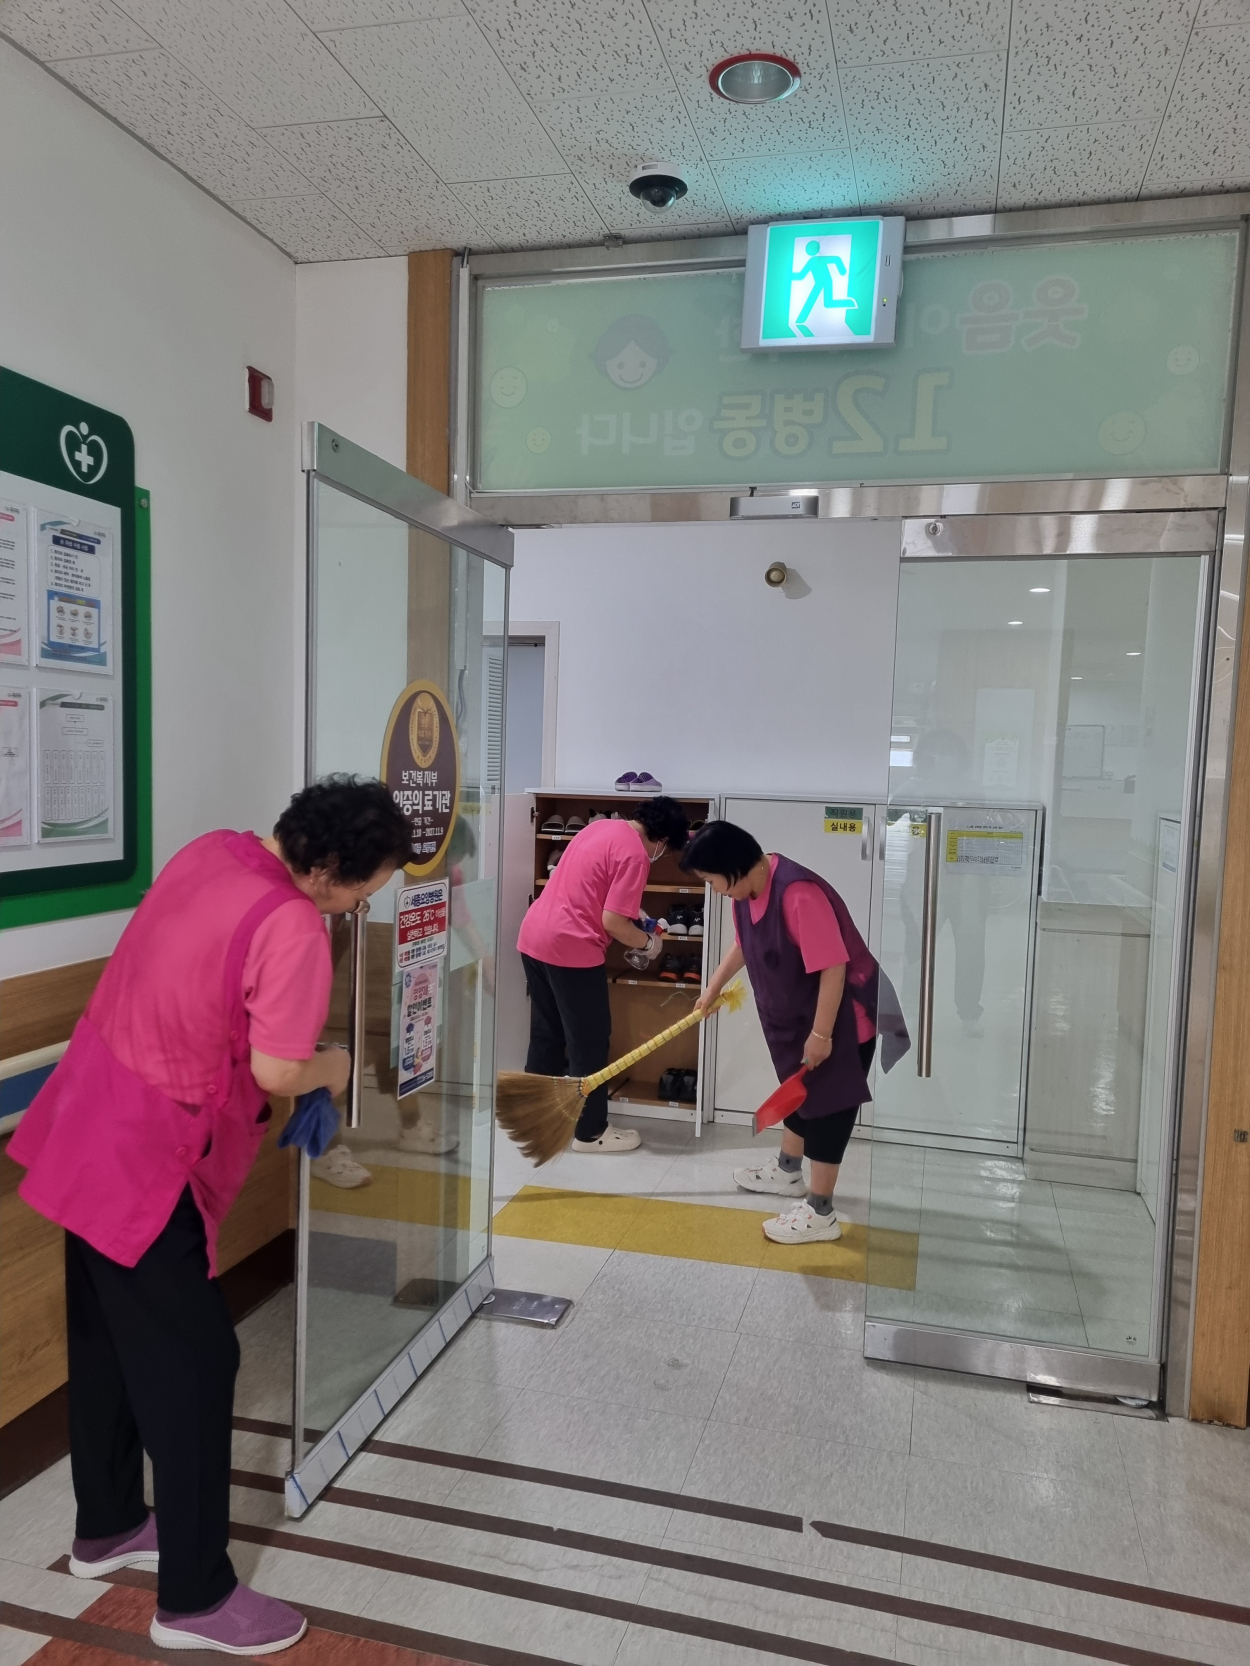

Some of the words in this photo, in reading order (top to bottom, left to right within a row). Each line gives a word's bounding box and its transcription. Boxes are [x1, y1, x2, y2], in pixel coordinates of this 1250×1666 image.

[401, 770, 438, 787] 보건복지부
[830, 808, 857, 818] 직원용
[830, 821, 857, 833] 실내용
[400, 912, 422, 928] 건강온도
